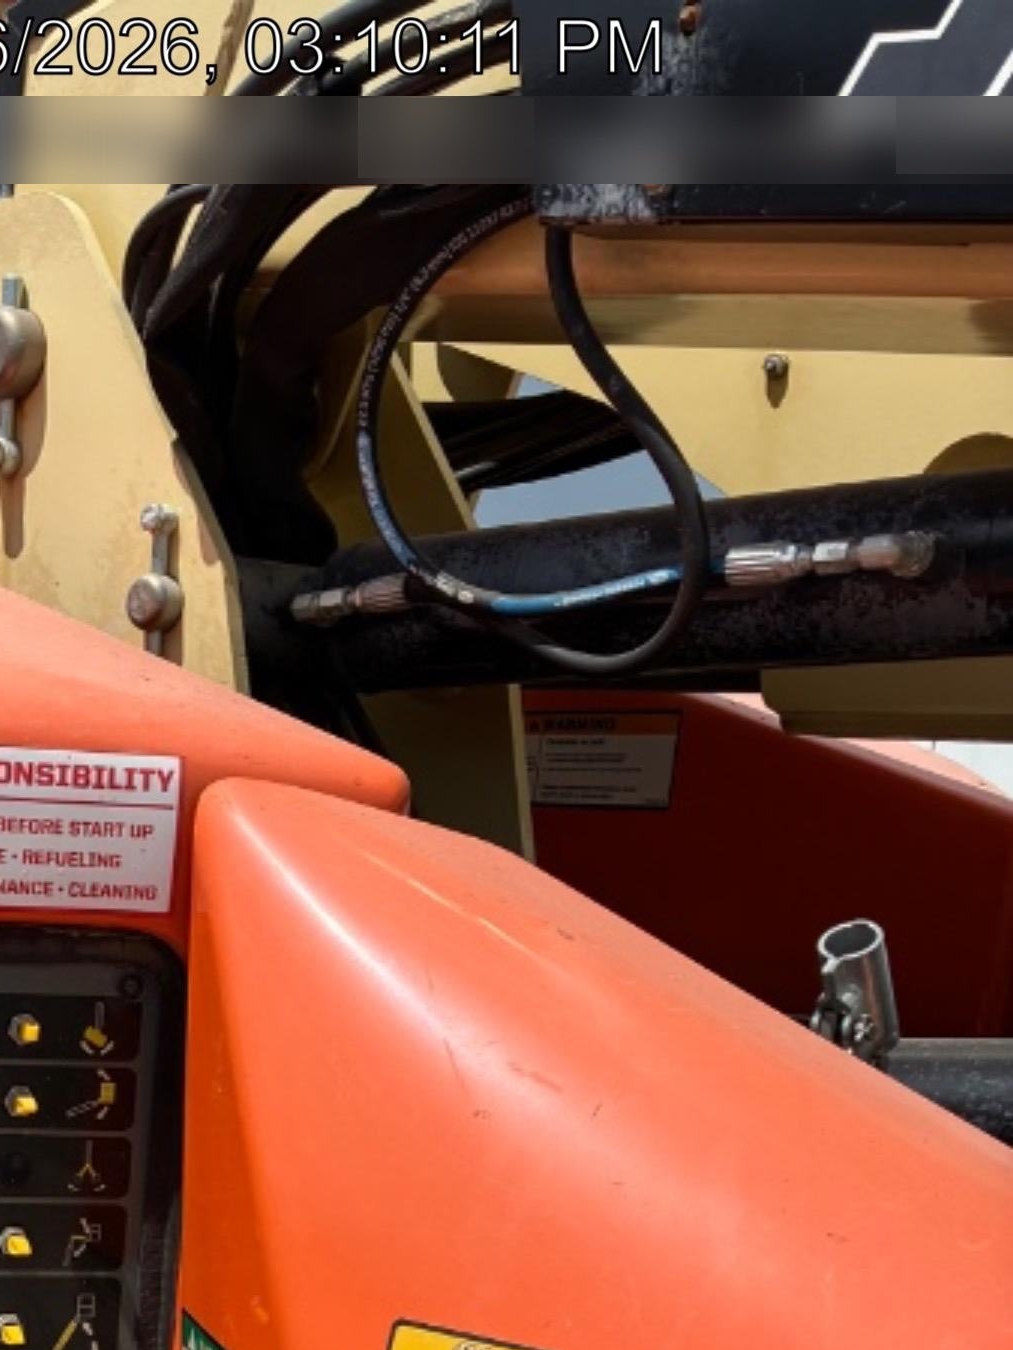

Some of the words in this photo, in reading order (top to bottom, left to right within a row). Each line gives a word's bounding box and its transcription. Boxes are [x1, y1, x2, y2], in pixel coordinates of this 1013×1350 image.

[68, 820, 125, 838] START
[130, 824, 155, 840] UP
[22, 850, 121, 869] REFUELING
[68, 882, 158, 901] CLEANING
